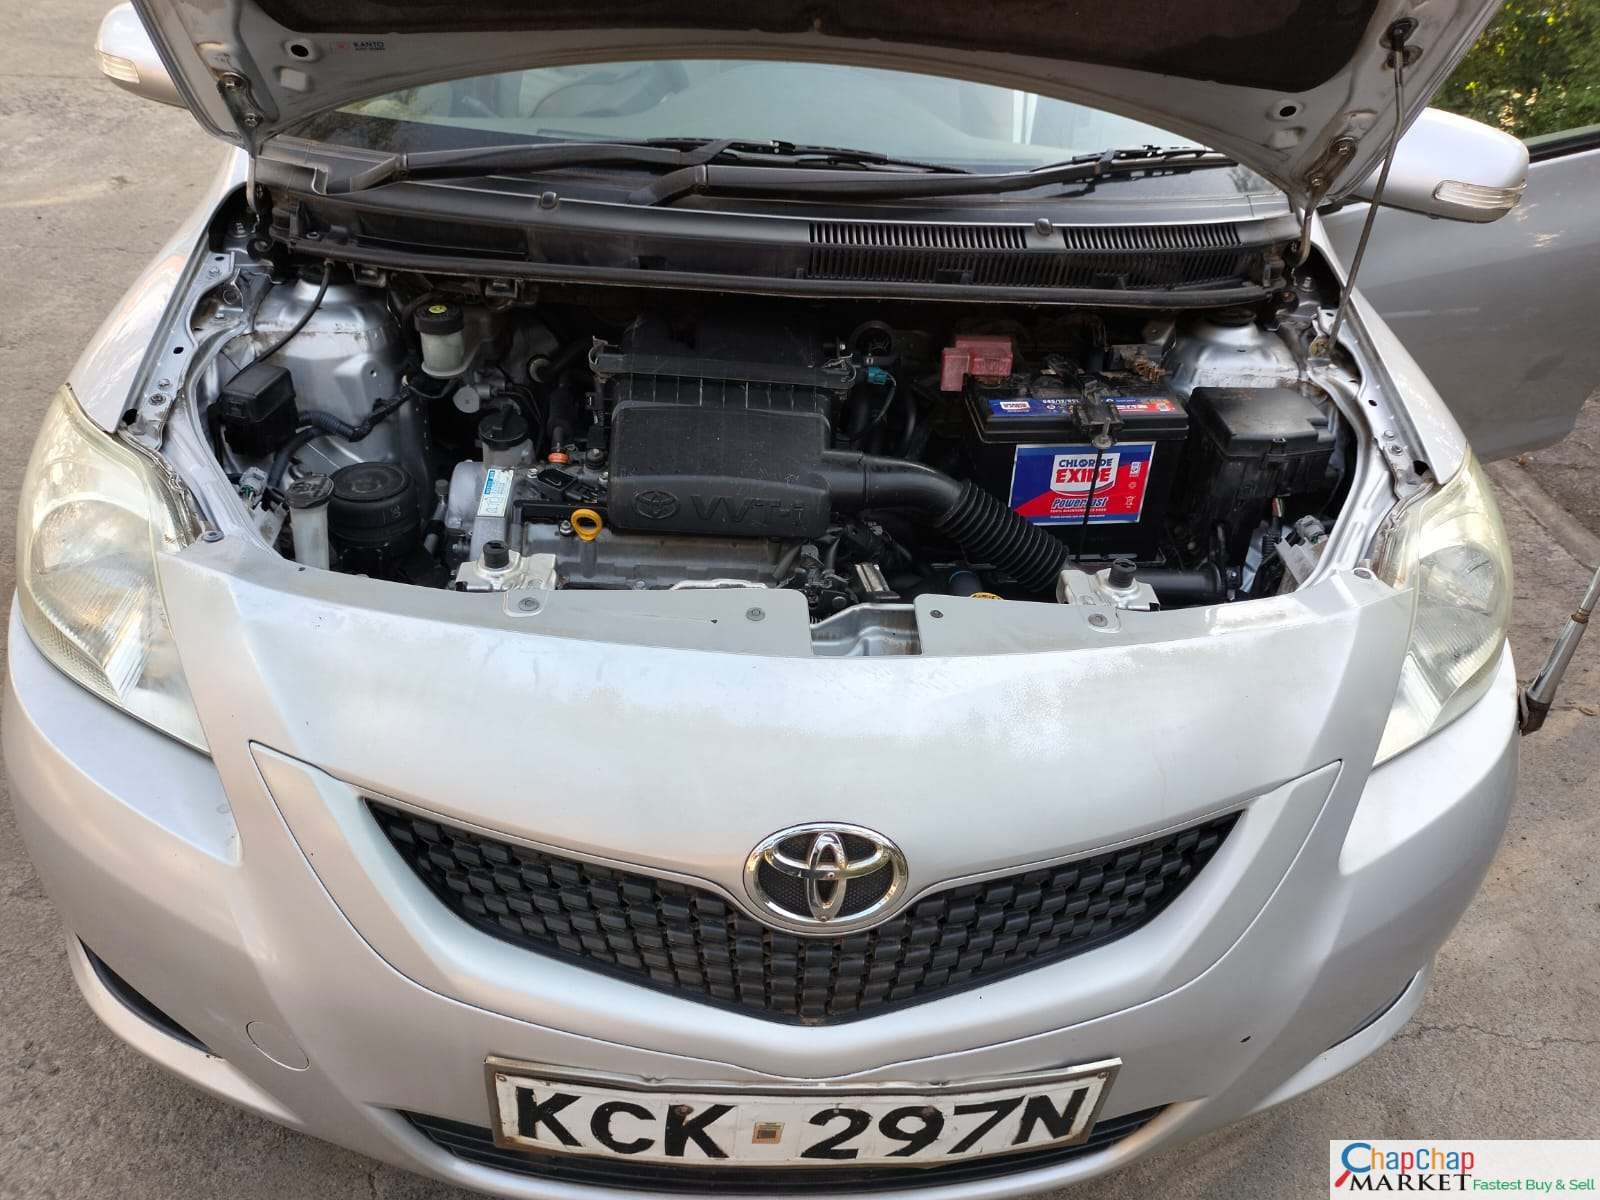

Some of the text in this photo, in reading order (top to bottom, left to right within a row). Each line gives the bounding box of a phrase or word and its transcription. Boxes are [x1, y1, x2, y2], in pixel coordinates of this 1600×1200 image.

[1058, 458, 1113, 468] CHLORDE
[515, 1086, 1090, 1160] KCK 297N
